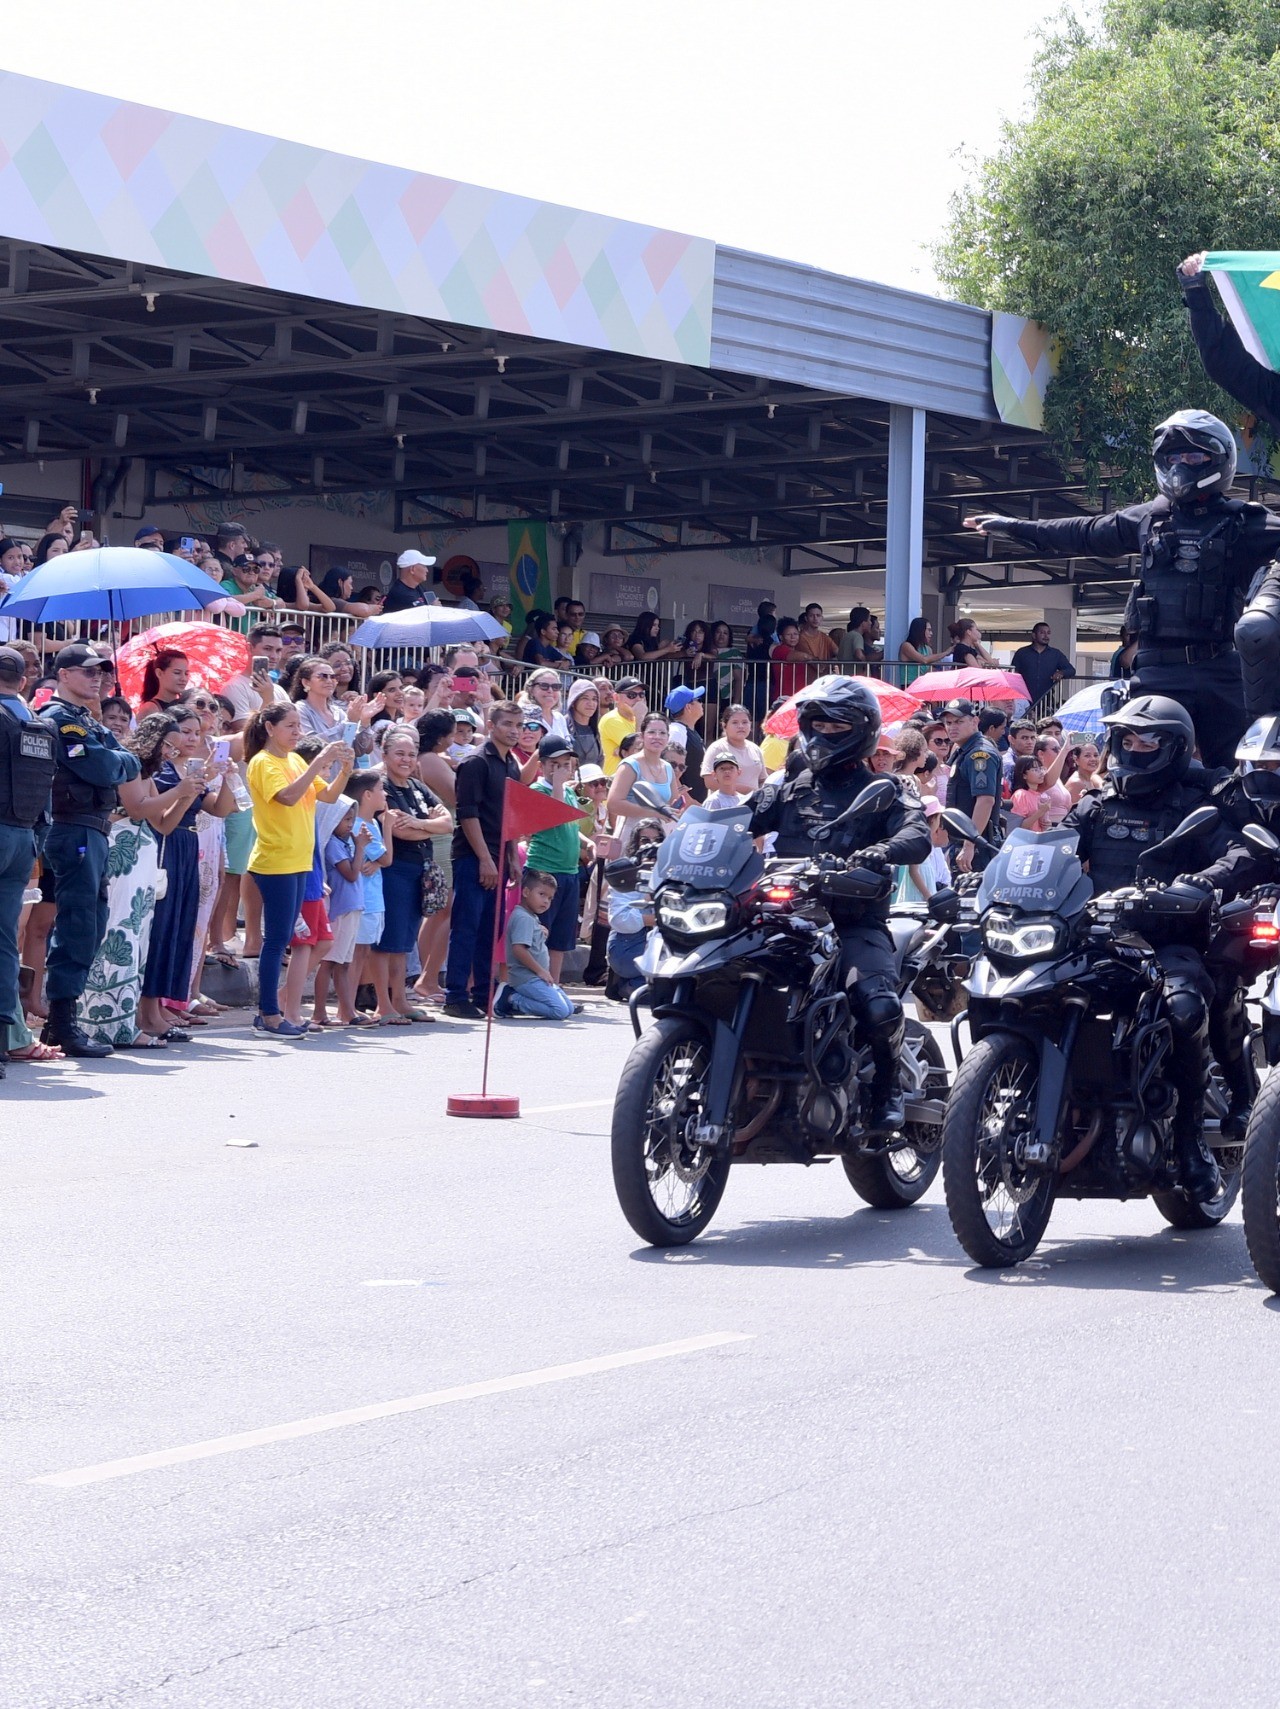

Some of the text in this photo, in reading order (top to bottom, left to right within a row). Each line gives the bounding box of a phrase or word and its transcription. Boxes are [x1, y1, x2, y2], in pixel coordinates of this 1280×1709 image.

[22, 735, 49, 748] POLÍCIA
[22, 744, 50, 757] MILITAR
[673, 864, 715, 877] PMRR
[1001, 886, 1044, 899] PMRR
